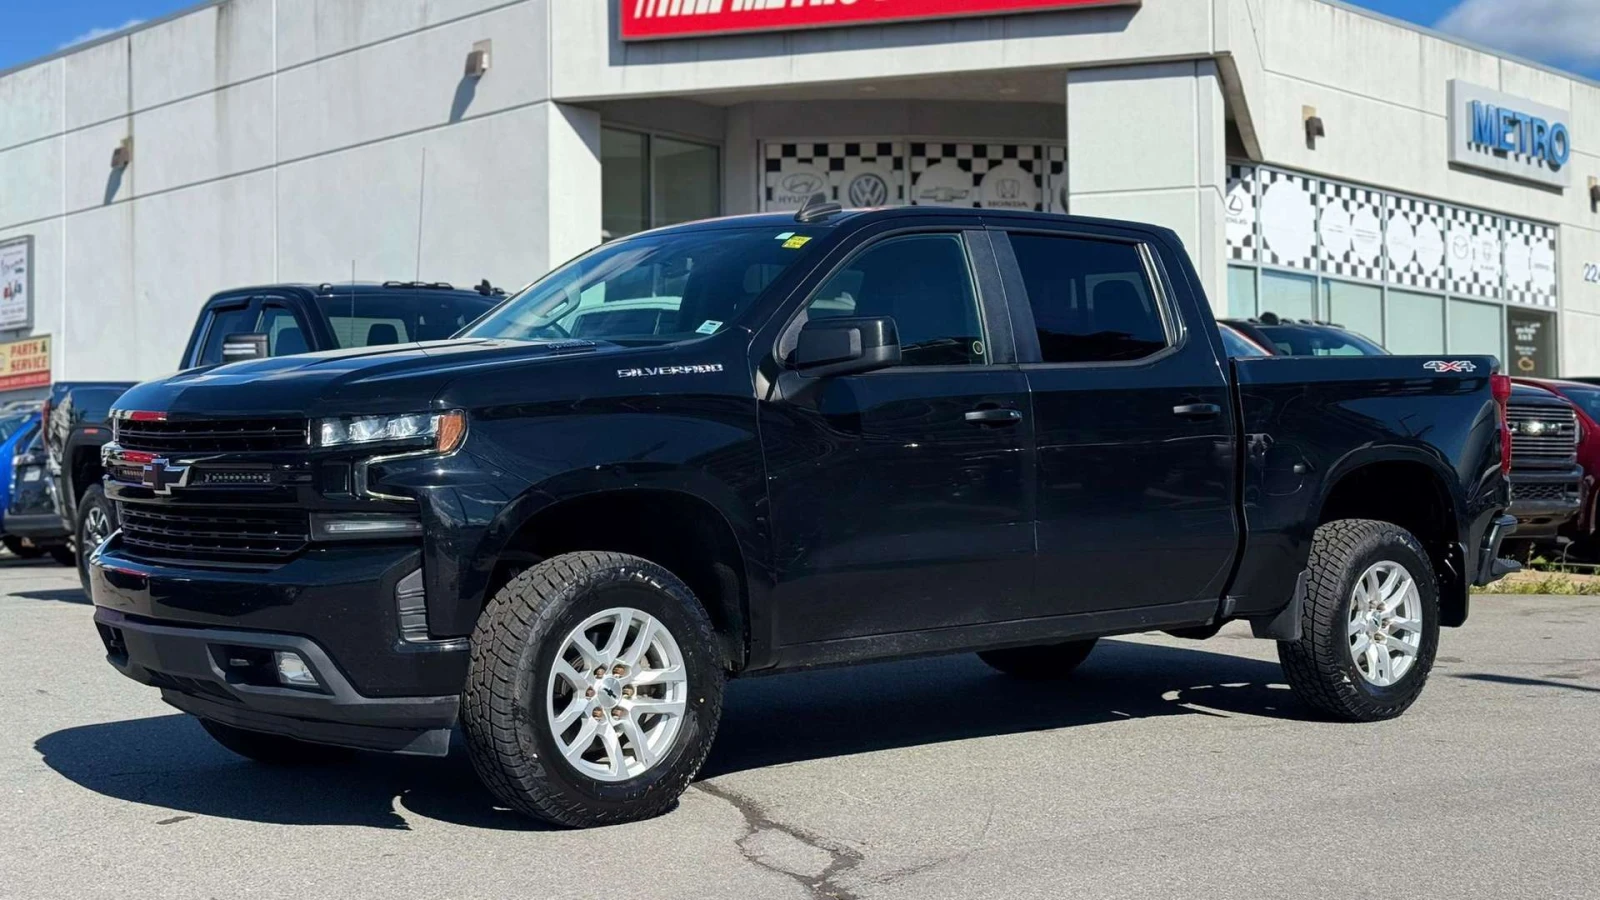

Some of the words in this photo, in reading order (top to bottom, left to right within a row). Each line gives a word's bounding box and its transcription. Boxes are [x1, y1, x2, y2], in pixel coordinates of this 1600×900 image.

[1470, 100, 1570, 166] METRO
[988, 200, 1029, 208] HONDA
[1583, 262, 1600, 283] 22
[10, 341, 38, 357] PARTS
[10, 355, 47, 371] SERVICE
[617, 363, 723, 378] SILVERADO
